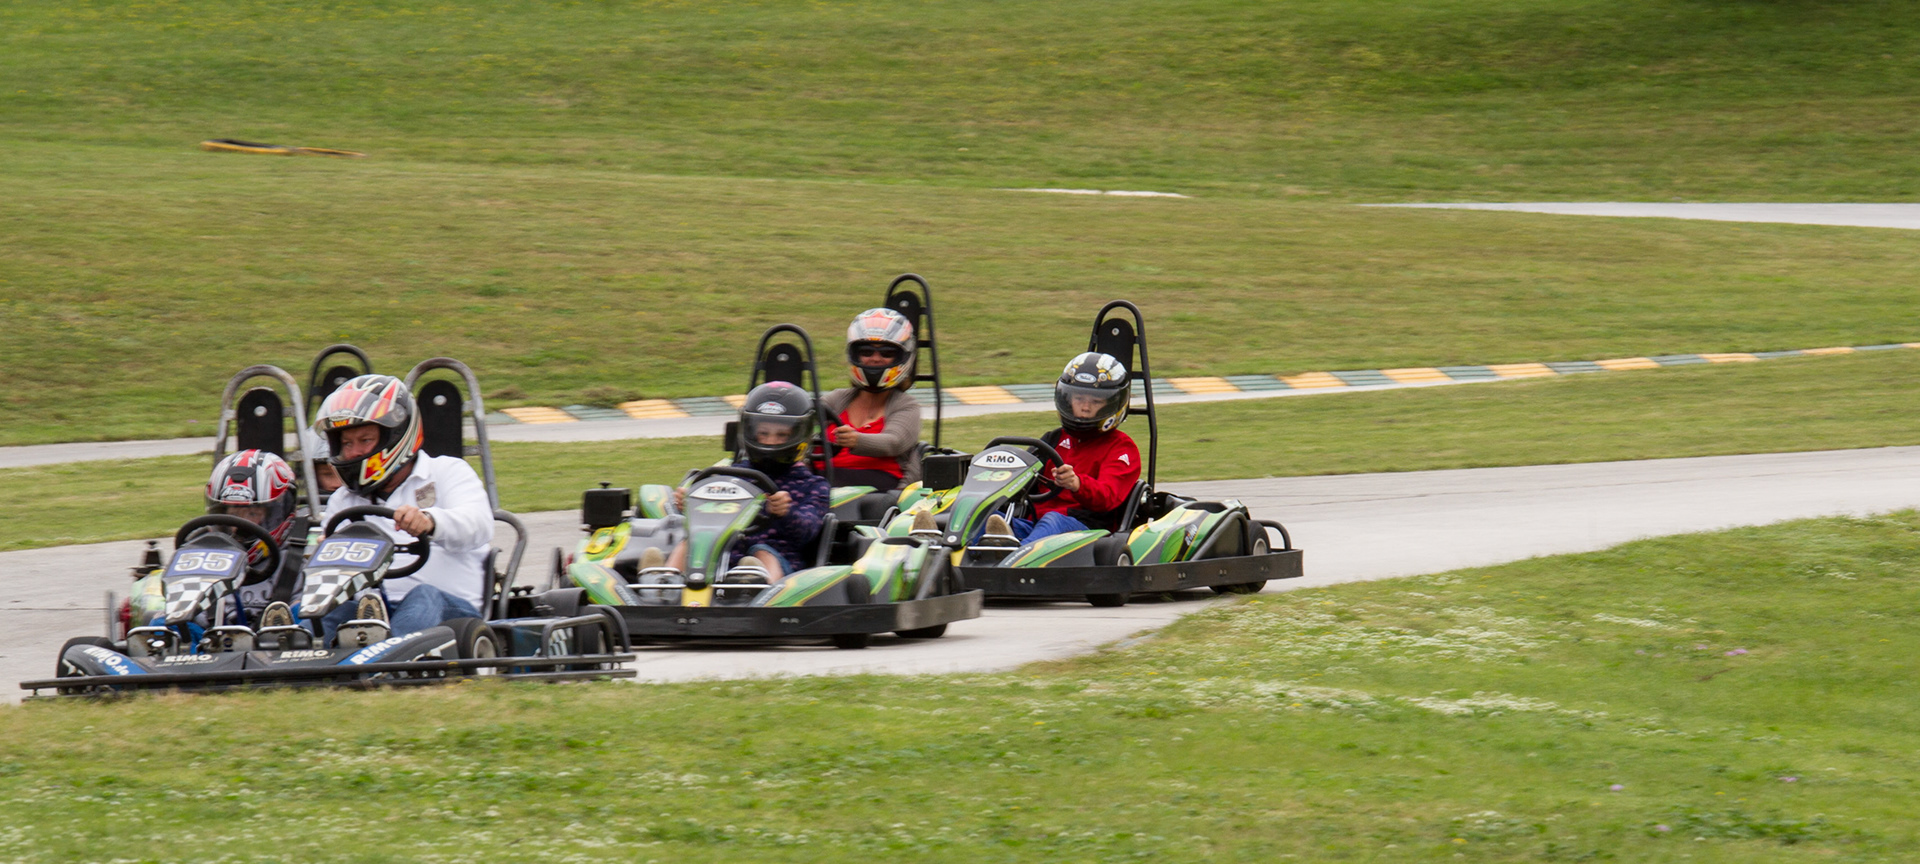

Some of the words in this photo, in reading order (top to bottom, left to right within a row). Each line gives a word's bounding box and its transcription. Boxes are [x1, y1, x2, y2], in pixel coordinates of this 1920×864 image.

[972, 470, 1013, 482] 49
[694, 501, 742, 514] 46
[316, 541, 380, 563] 55
[173, 551, 235, 573] 55
